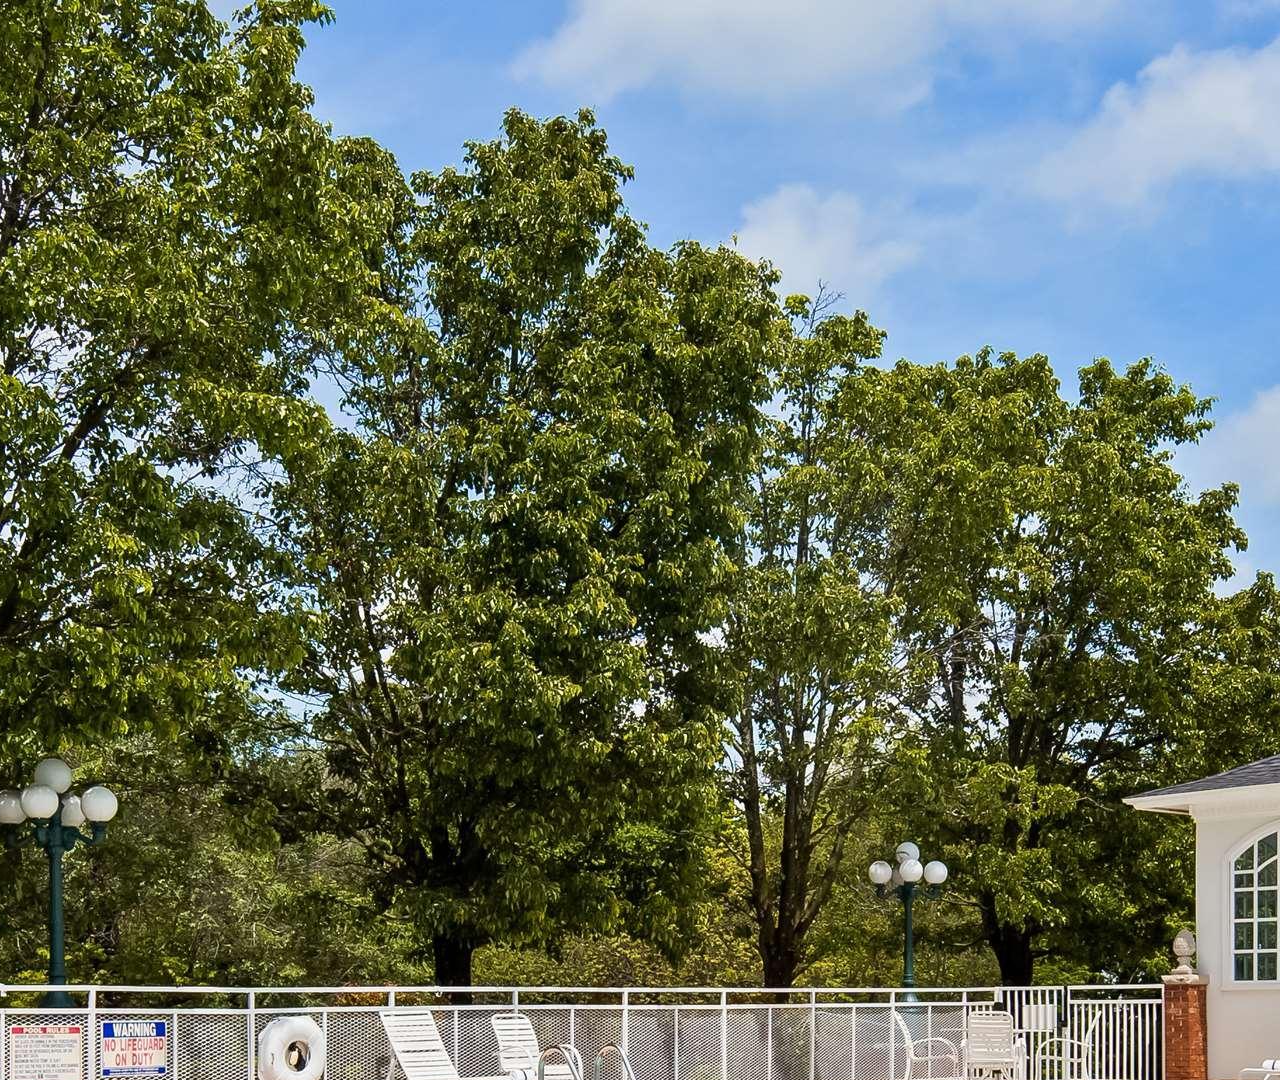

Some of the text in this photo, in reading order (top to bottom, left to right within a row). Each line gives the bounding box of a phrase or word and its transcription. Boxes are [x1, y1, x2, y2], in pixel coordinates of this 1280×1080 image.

[113, 1023, 156, 1037] WARNING
[104, 1038, 164, 1052] NO LIFEGUARD
[115, 1053, 153, 1066] ON DUTY
